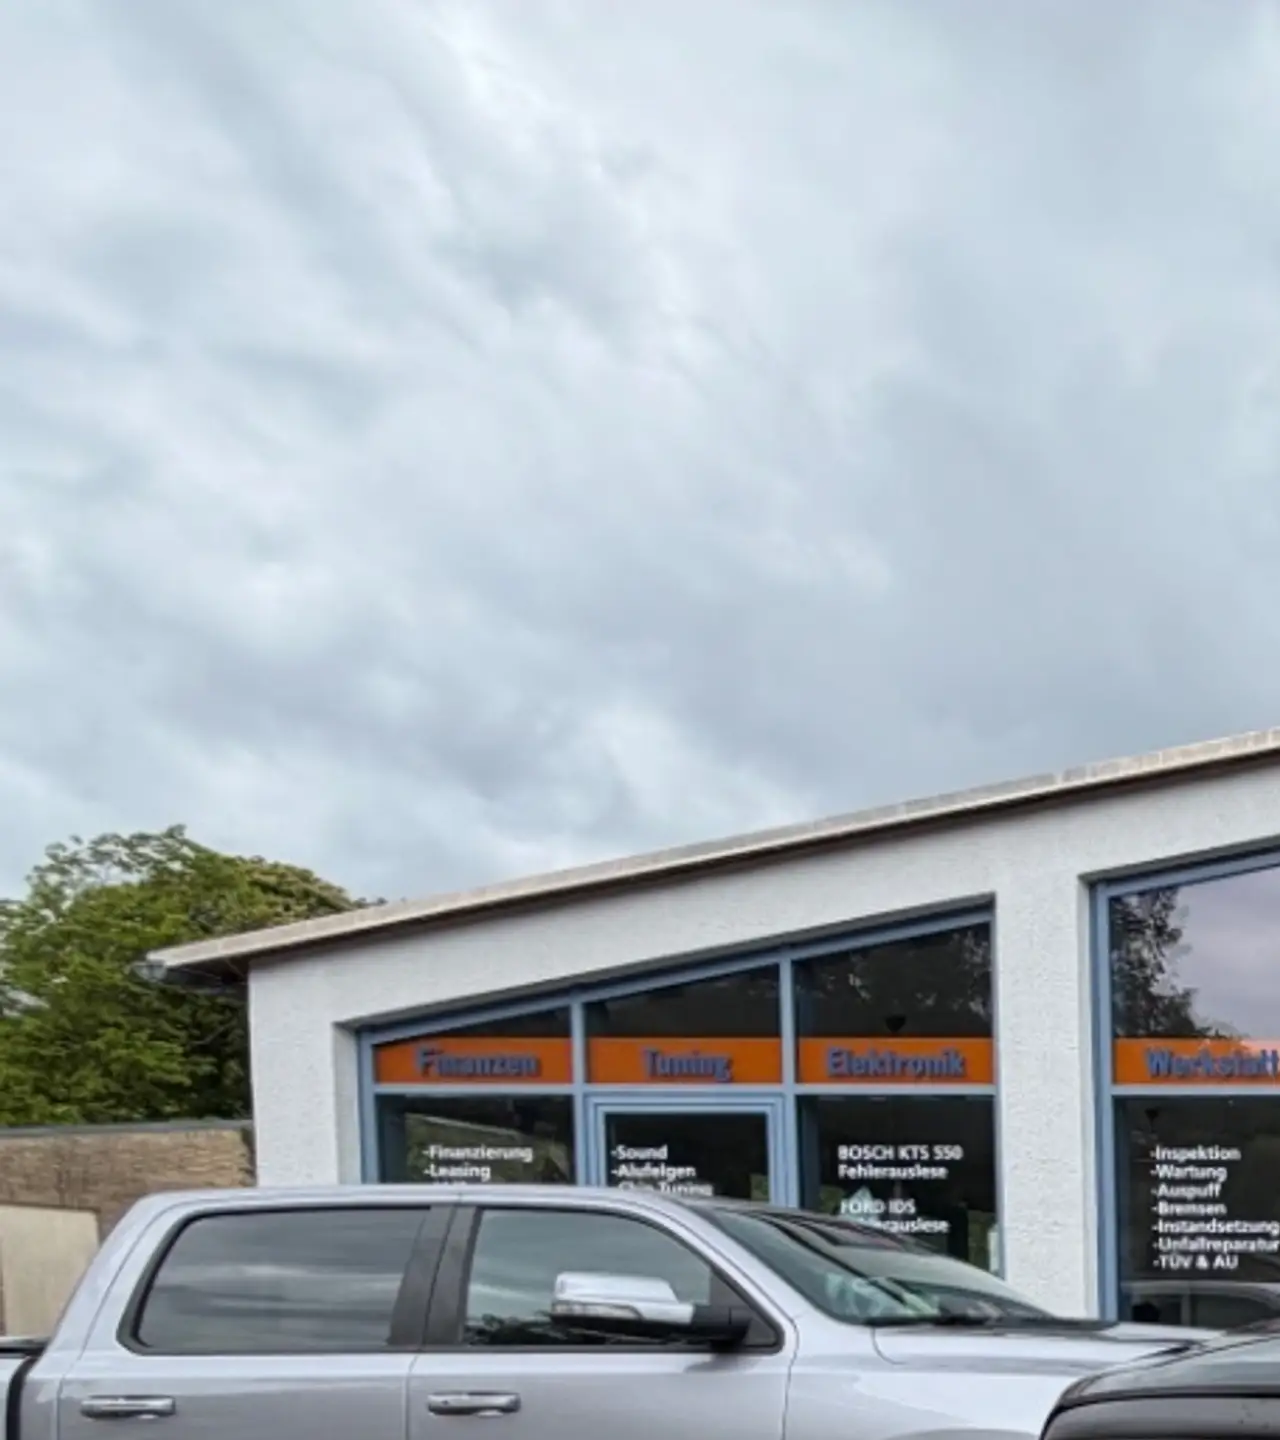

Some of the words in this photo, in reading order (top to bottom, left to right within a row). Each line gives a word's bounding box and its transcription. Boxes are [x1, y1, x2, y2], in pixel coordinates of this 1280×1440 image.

[416, 1046, 541, 1078] Finanzen
[642, 1046, 732, 1084] Tuning
[827, 1046, 967, 1078] Elektronik
[837, 1145, 894, 1160] BOSCH
[897, 1145, 930, 1160] KTS
[837, 1164, 948, 1180] Fehlerauslese
[1195, 1255, 1209, 1269] &
[1213, 1255, 1239, 1269] AU
